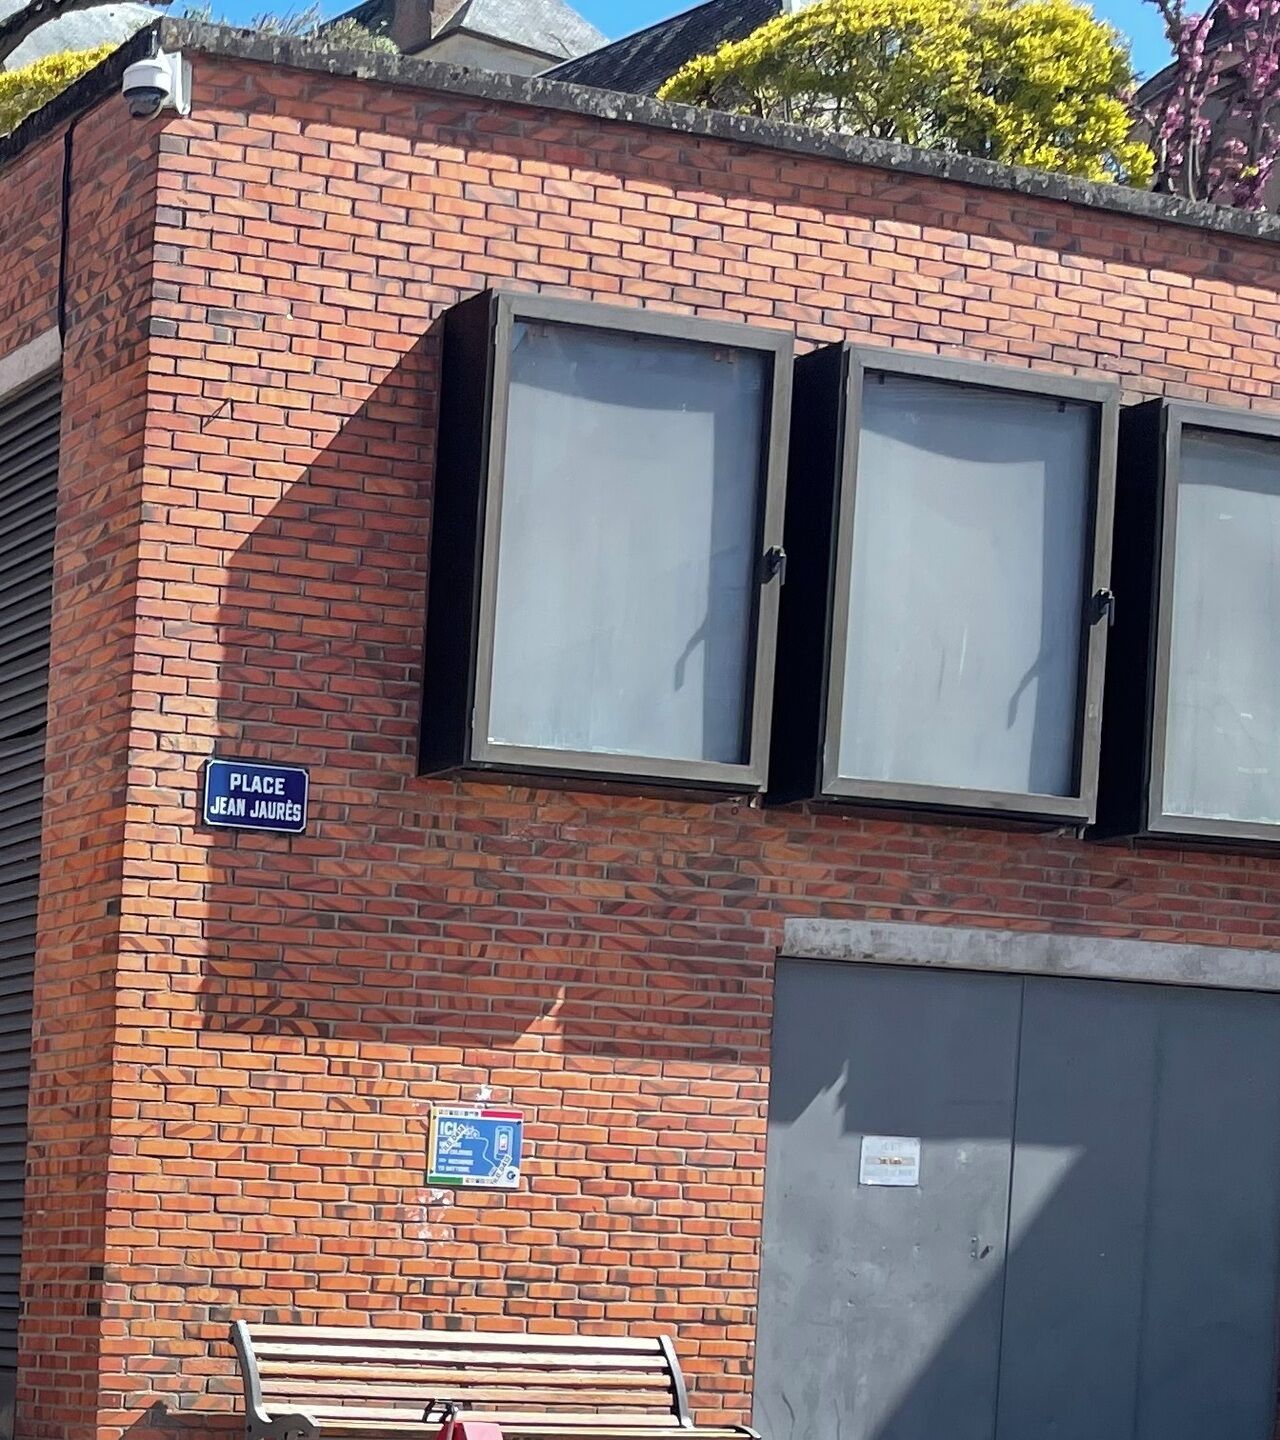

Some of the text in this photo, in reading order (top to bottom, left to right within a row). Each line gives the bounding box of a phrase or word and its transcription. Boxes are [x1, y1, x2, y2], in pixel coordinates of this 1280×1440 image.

[230, 773, 285, 795] PLACE
[210, 795, 302, 822] JEAN JAURÈS
